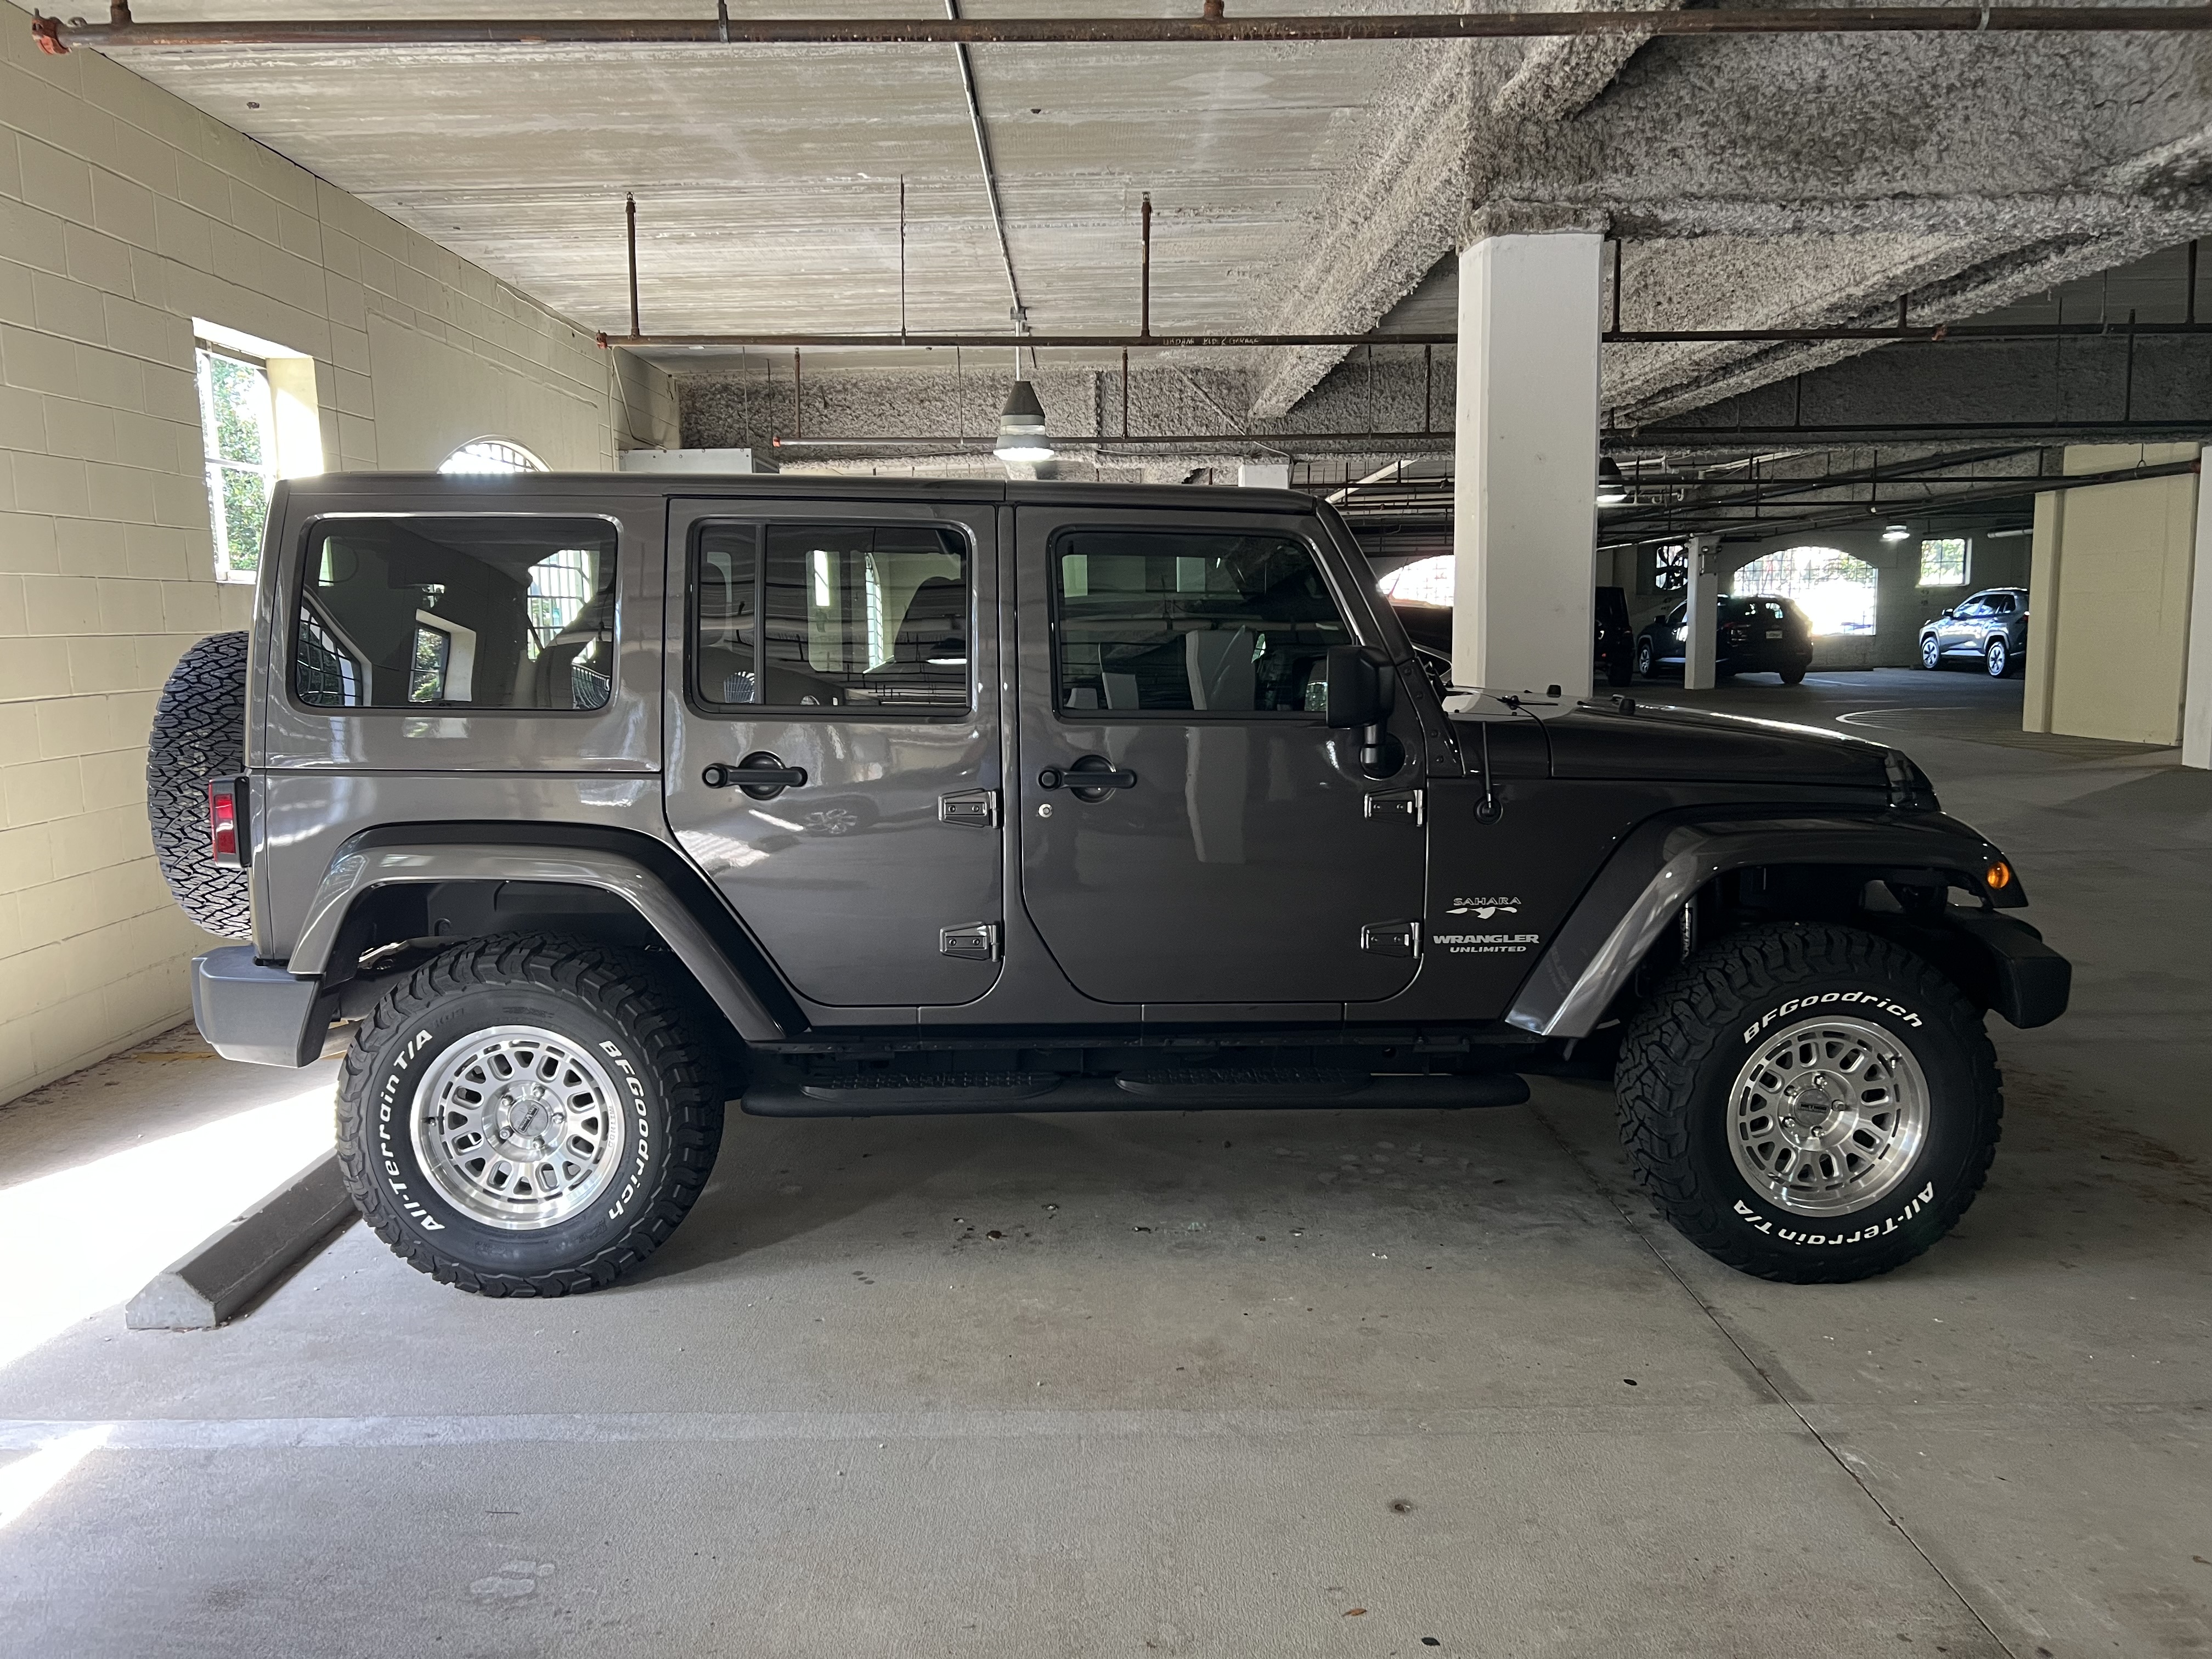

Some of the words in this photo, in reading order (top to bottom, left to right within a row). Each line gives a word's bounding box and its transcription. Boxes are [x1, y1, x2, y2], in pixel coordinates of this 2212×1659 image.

[1453, 897, 1521, 906] SAHARA
[1433, 934, 1539, 944] WRANGLER
[1743, 991, 1922, 1043] BFGoodrich
[394, 1029, 433, 1069] T/A
[379, 1074, 445, 1230] All-Terrain
[599, 1040, 650, 1220] BFGoodrich
[1734, 1200, 1773, 1234] T/A
[1778, 1181, 1934, 1245] All-Terrain
